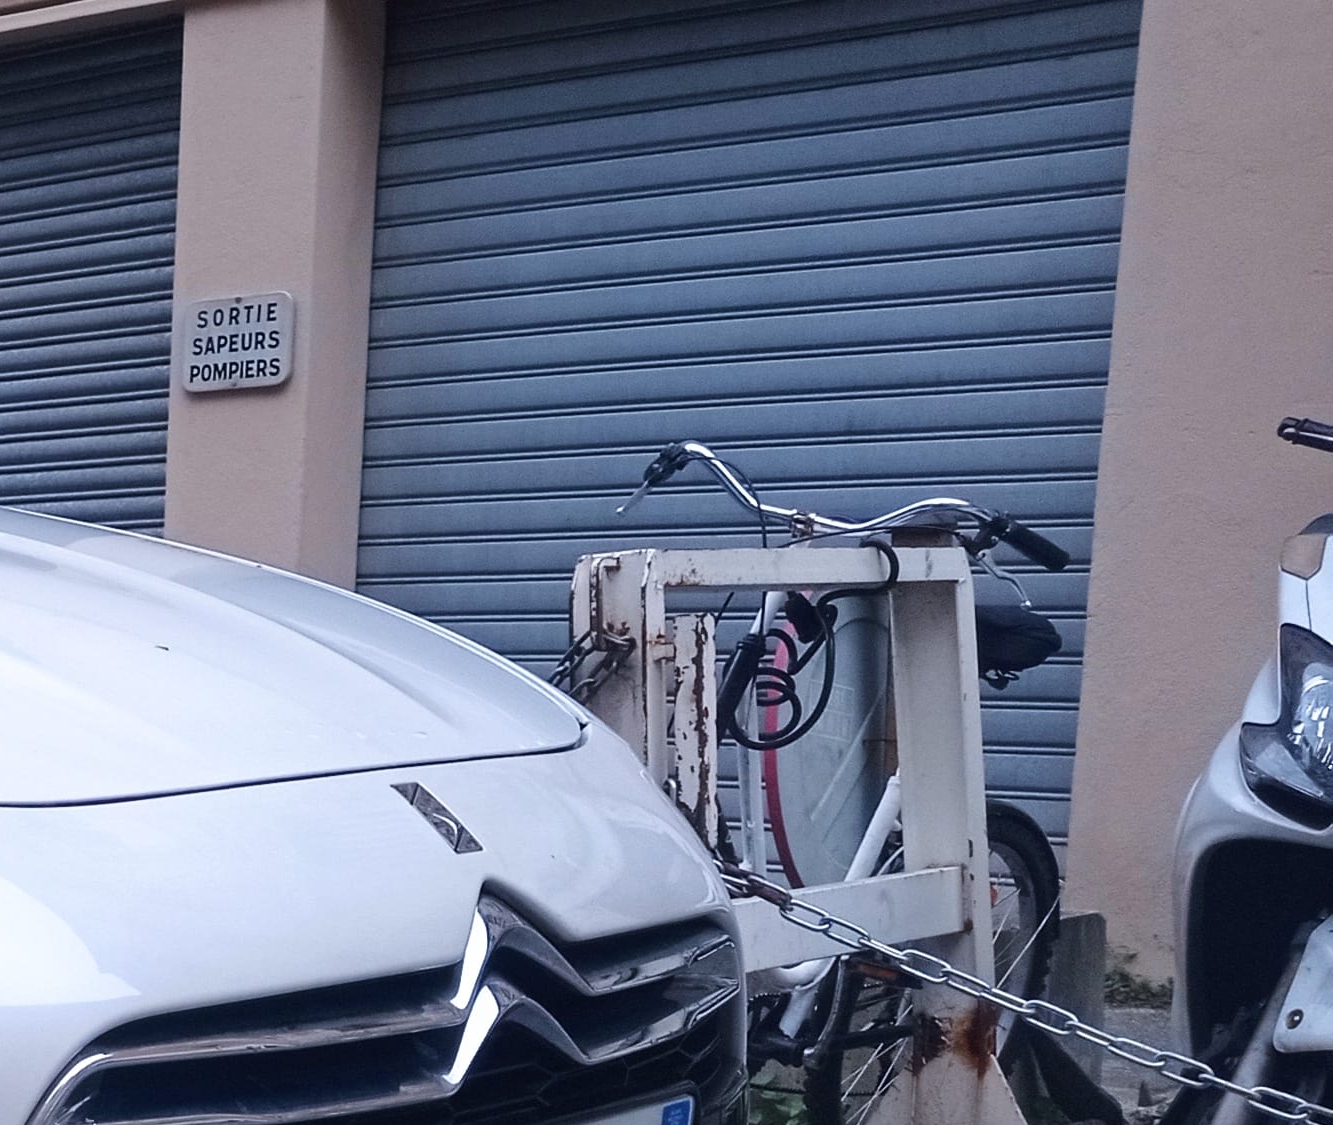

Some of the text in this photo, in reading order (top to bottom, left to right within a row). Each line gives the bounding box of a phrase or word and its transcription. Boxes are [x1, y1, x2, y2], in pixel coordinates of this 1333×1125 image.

[197, 302, 278, 329] SORTIE
[192, 330, 281, 356] SAPEURS
[189, 358, 281, 384] POMPIERS
